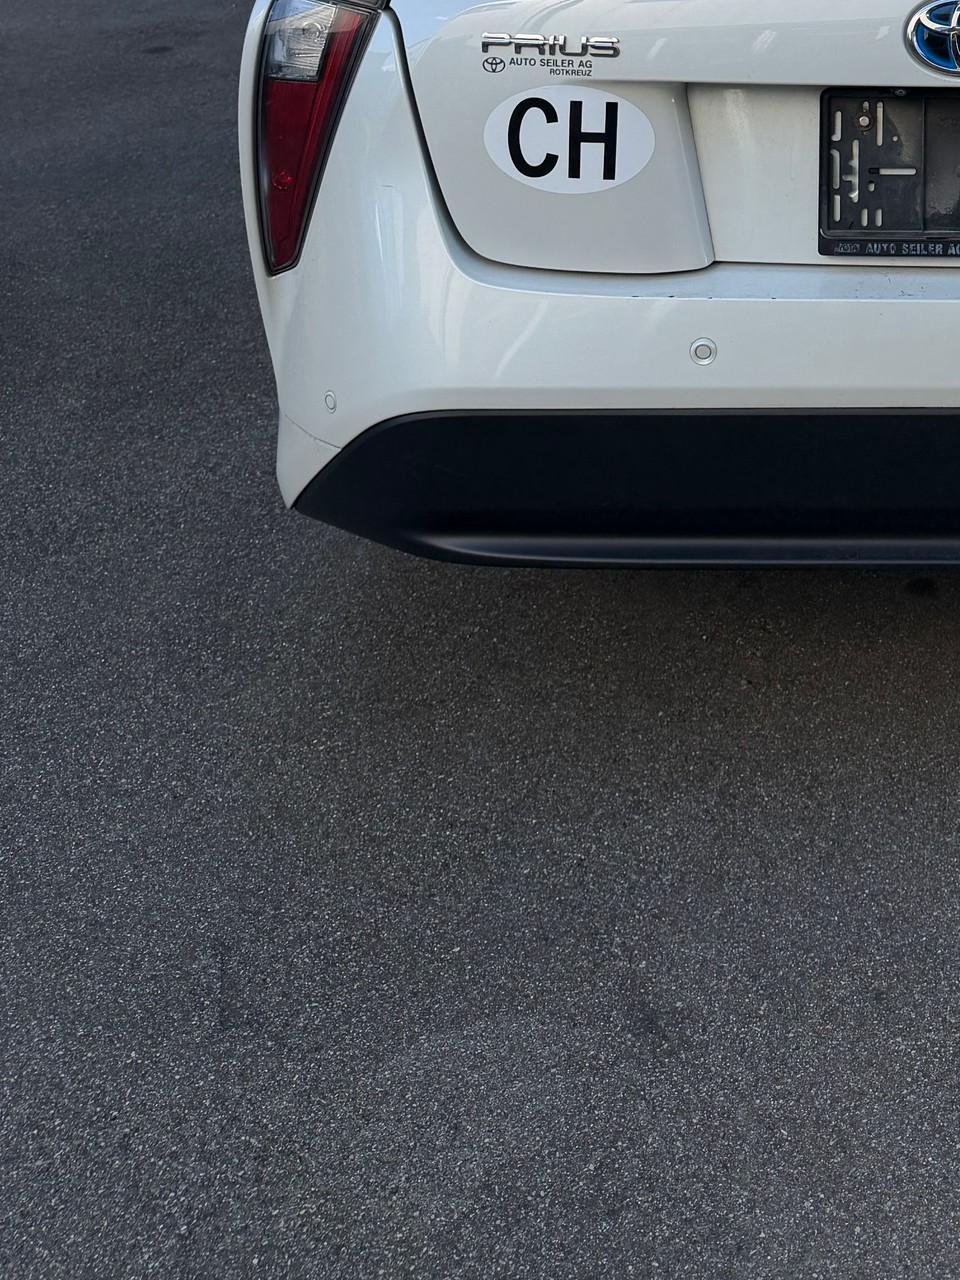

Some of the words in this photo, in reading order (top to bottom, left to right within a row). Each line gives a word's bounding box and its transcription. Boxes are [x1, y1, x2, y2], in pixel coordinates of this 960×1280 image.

[482, 32, 620, 58] PRIUS
[509, 58, 536, 67] AUTO
[540, 59, 574, 68] SEILER
[578, 60, 593, 69] AG
[549, 69, 592, 77] ROTKREUZ
[507, 97, 619, 180] CH
[865, 243, 896, 254] AUTO
[902, 243, 943, 255] SEILER
